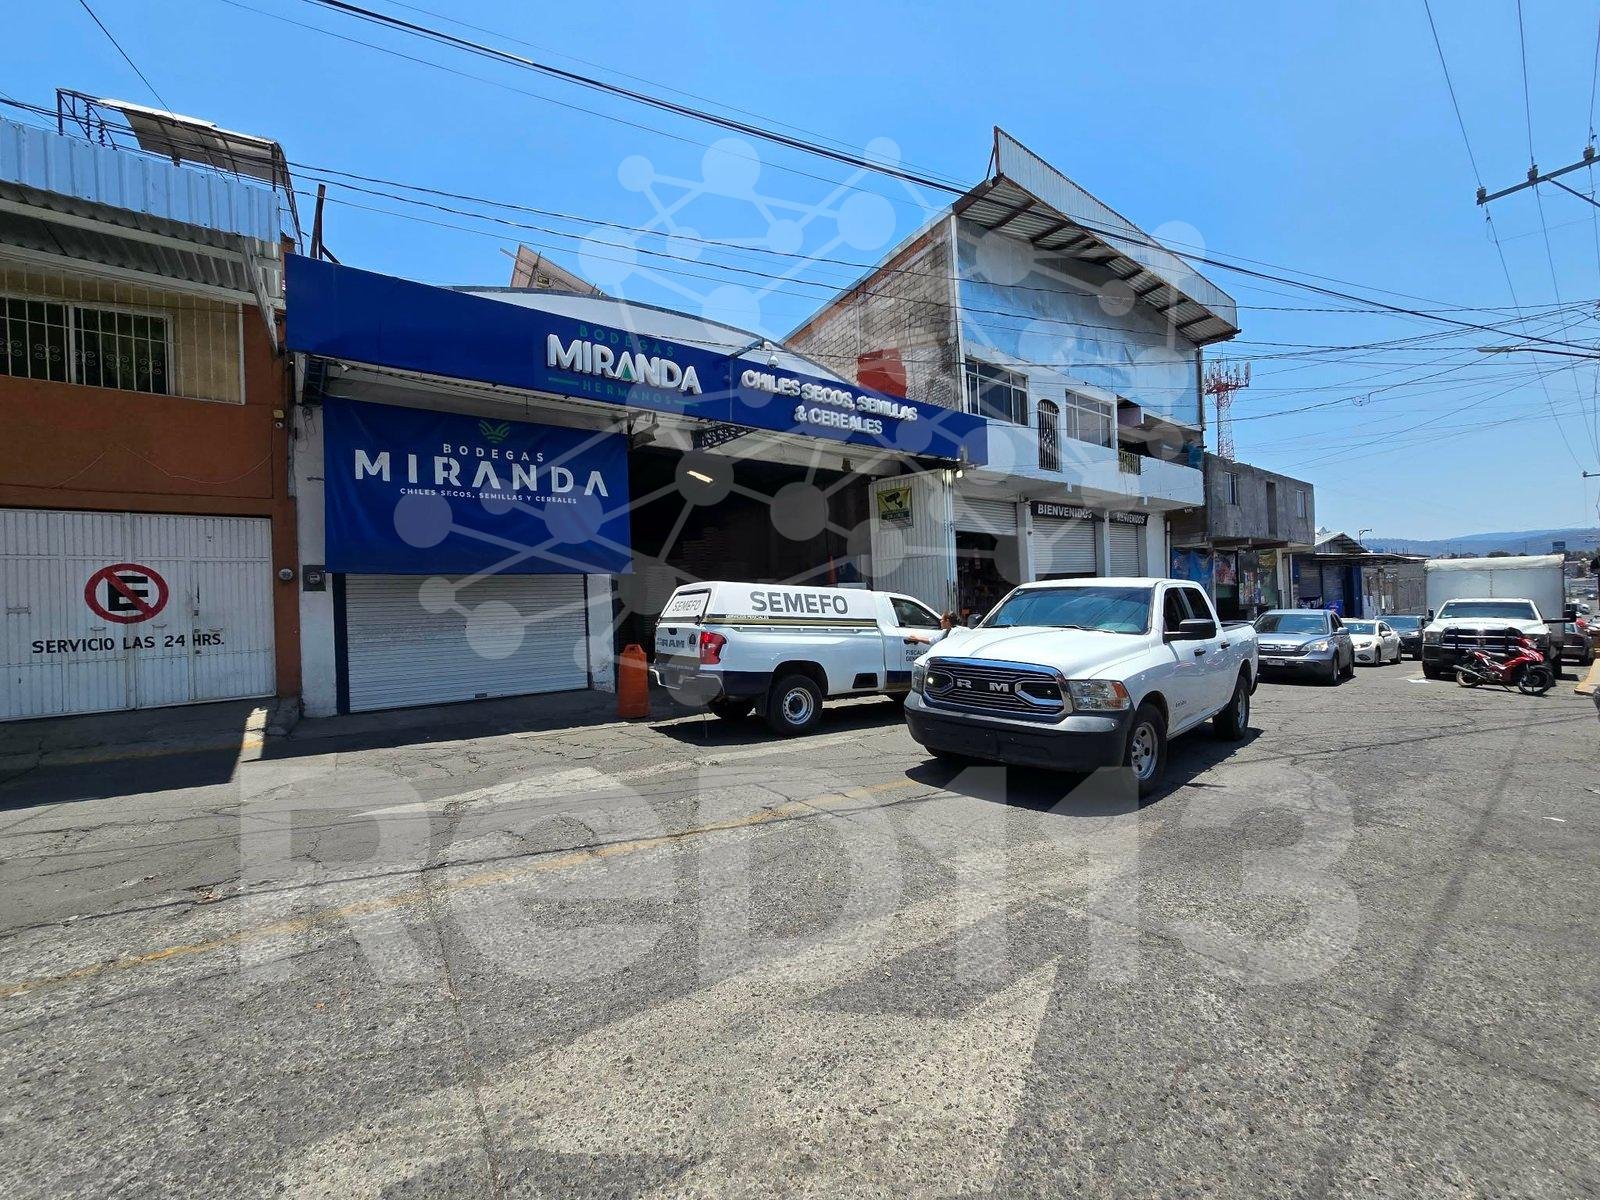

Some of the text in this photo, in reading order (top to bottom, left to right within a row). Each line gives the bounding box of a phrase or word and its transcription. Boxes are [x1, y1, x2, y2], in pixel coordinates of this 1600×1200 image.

[579, 324, 675, 357] BODEGAS
[547, 333, 703, 395] MIRANDA
[582, 379, 672, 406] HERMANOS
[741, 369, 918, 422] CHILES SECOS, SEMILLAS
[794, 405, 883, 435] & CEREALES
[442, 443, 544, 462] BODEGAS
[354, 448, 609, 497] MIRANDA
[400, 487, 437, 496] CHILES
[440, 489, 475, 499] SECOS,
[478, 492, 523, 501] SEMILLAS
[535, 495, 578, 504] CEREALES
[1037, 503, 1093, 519] BIENVENIDOS
[672, 599, 703, 613] SEMEFO
[749, 591, 849, 615] SEMEFO
[31, 633, 225, 654] SERVICIO LAS 24 HRS.
[661, 638, 685, 649] RAM
